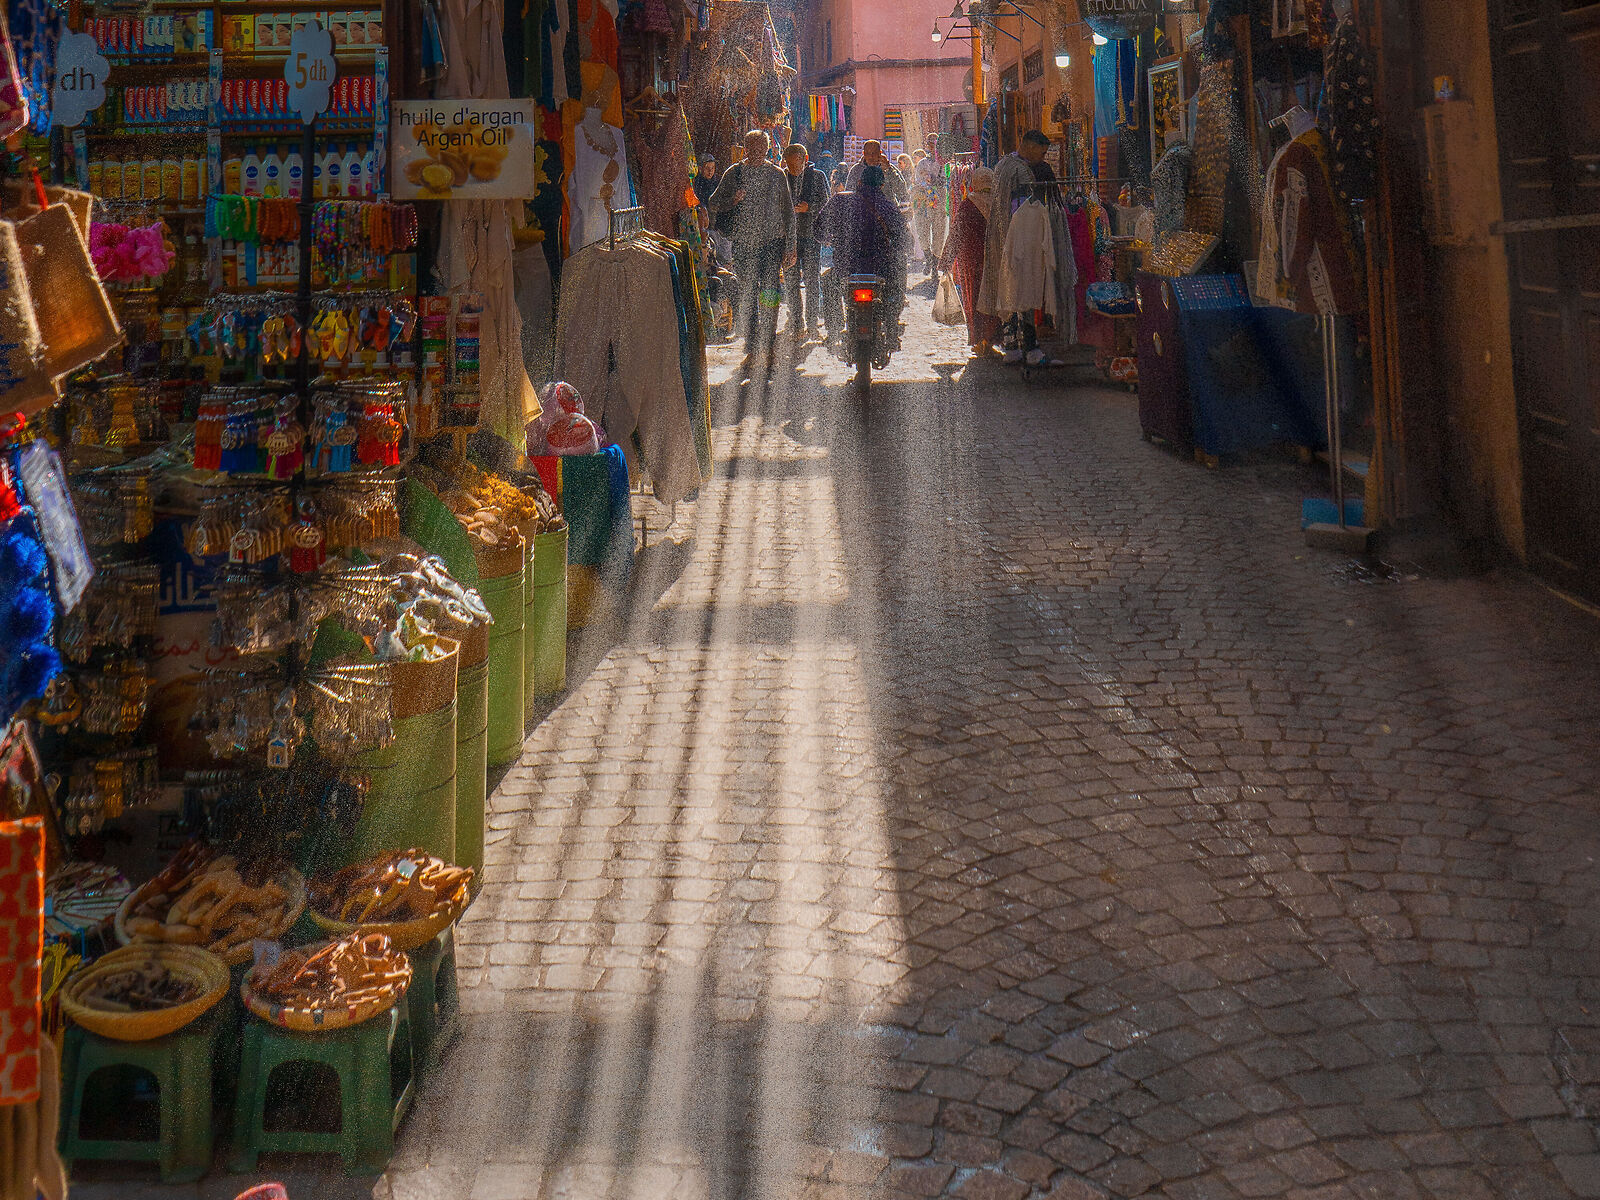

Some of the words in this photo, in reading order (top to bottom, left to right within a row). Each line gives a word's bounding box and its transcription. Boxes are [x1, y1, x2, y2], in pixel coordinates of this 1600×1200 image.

[400, 108, 445, 126] huile
[453, 107, 524, 129] d'argan
[417, 130, 473, 150] Argan
[481, 128, 506, 146] Oil
